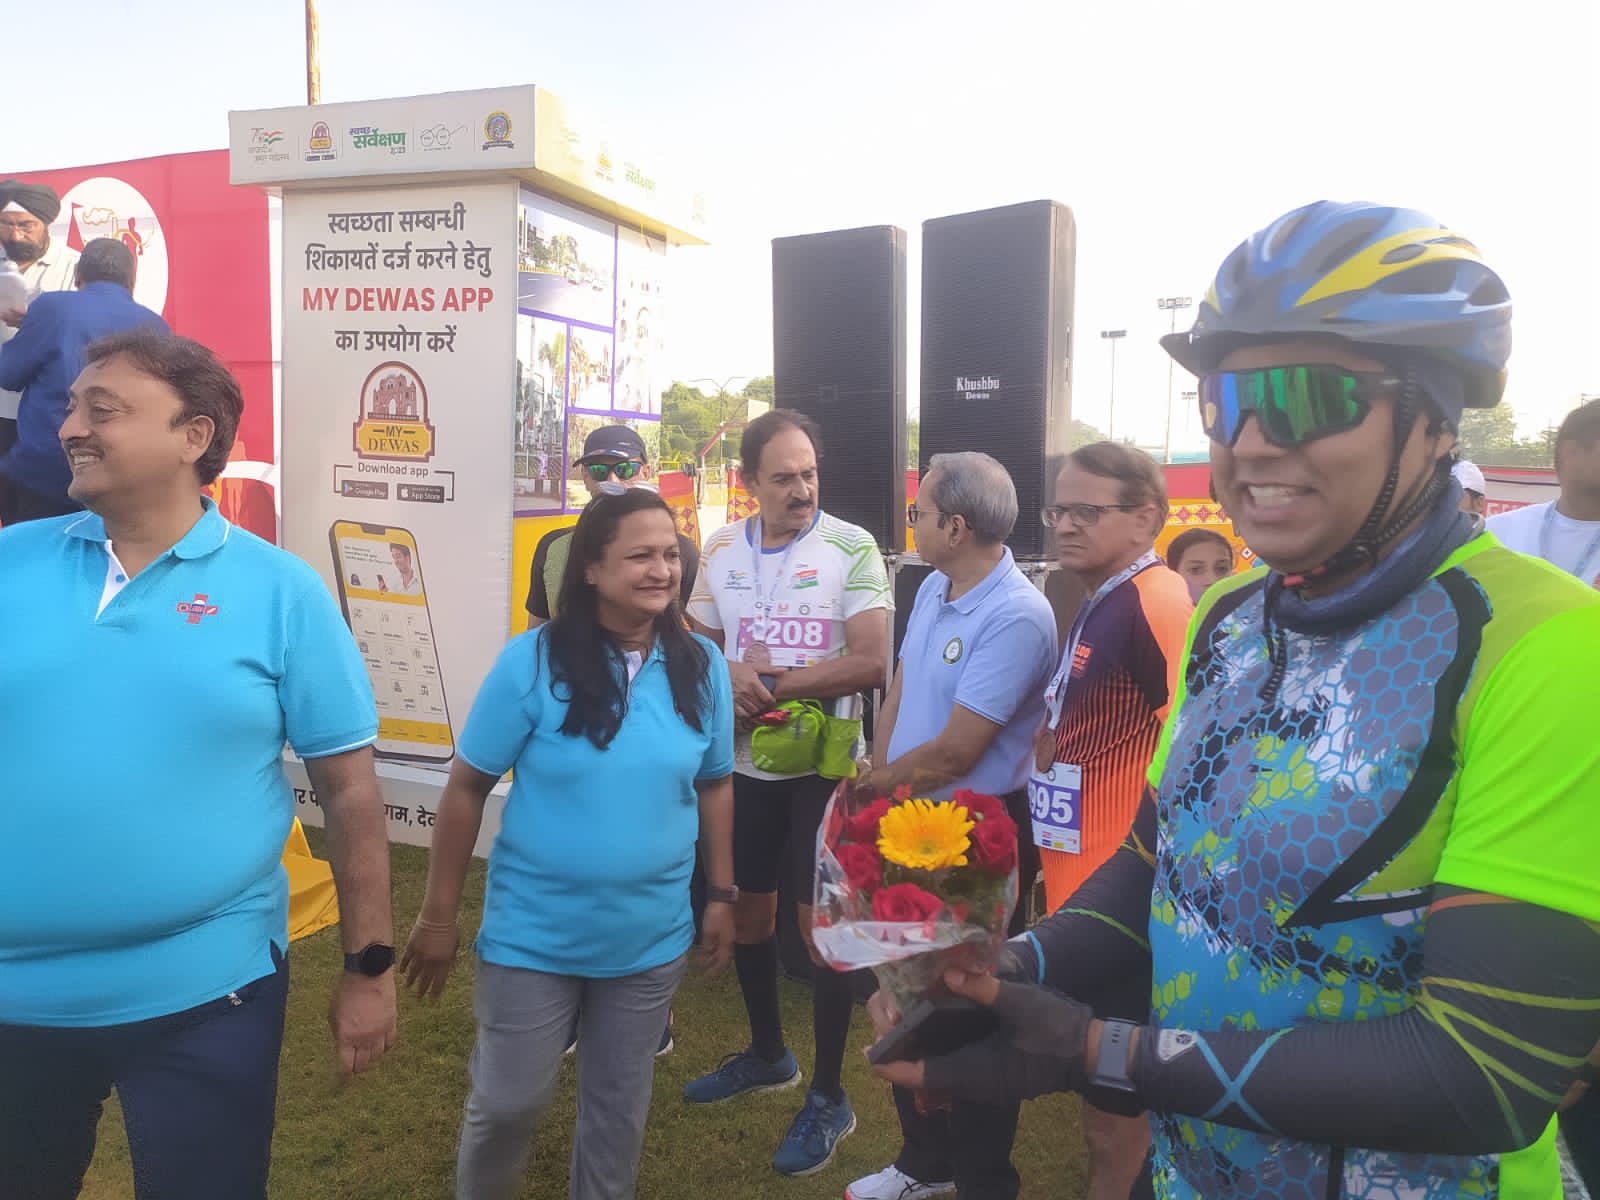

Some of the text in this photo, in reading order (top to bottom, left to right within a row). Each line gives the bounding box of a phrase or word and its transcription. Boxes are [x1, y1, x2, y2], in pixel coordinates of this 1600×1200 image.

[353, 128, 406, 148] सर्वेक्षण
[328, 202, 466, 233] स्वच्छता सम्बन्धी
[305, 240, 492, 278] शिकायतें दर्ज करने हेतु
[303, 288, 494, 312] MY DEWAS APP
[335, 324, 457, 352] का उपयोग करें
[957, 376, 1000, 391] Khushbu
[386, 426, 402, 437] MY
[368, 438, 420, 453] DEWAS
[358, 462, 429, 477] Download app
[746, 620, 823, 646] 208
[384, 804, 413, 827] गम,
